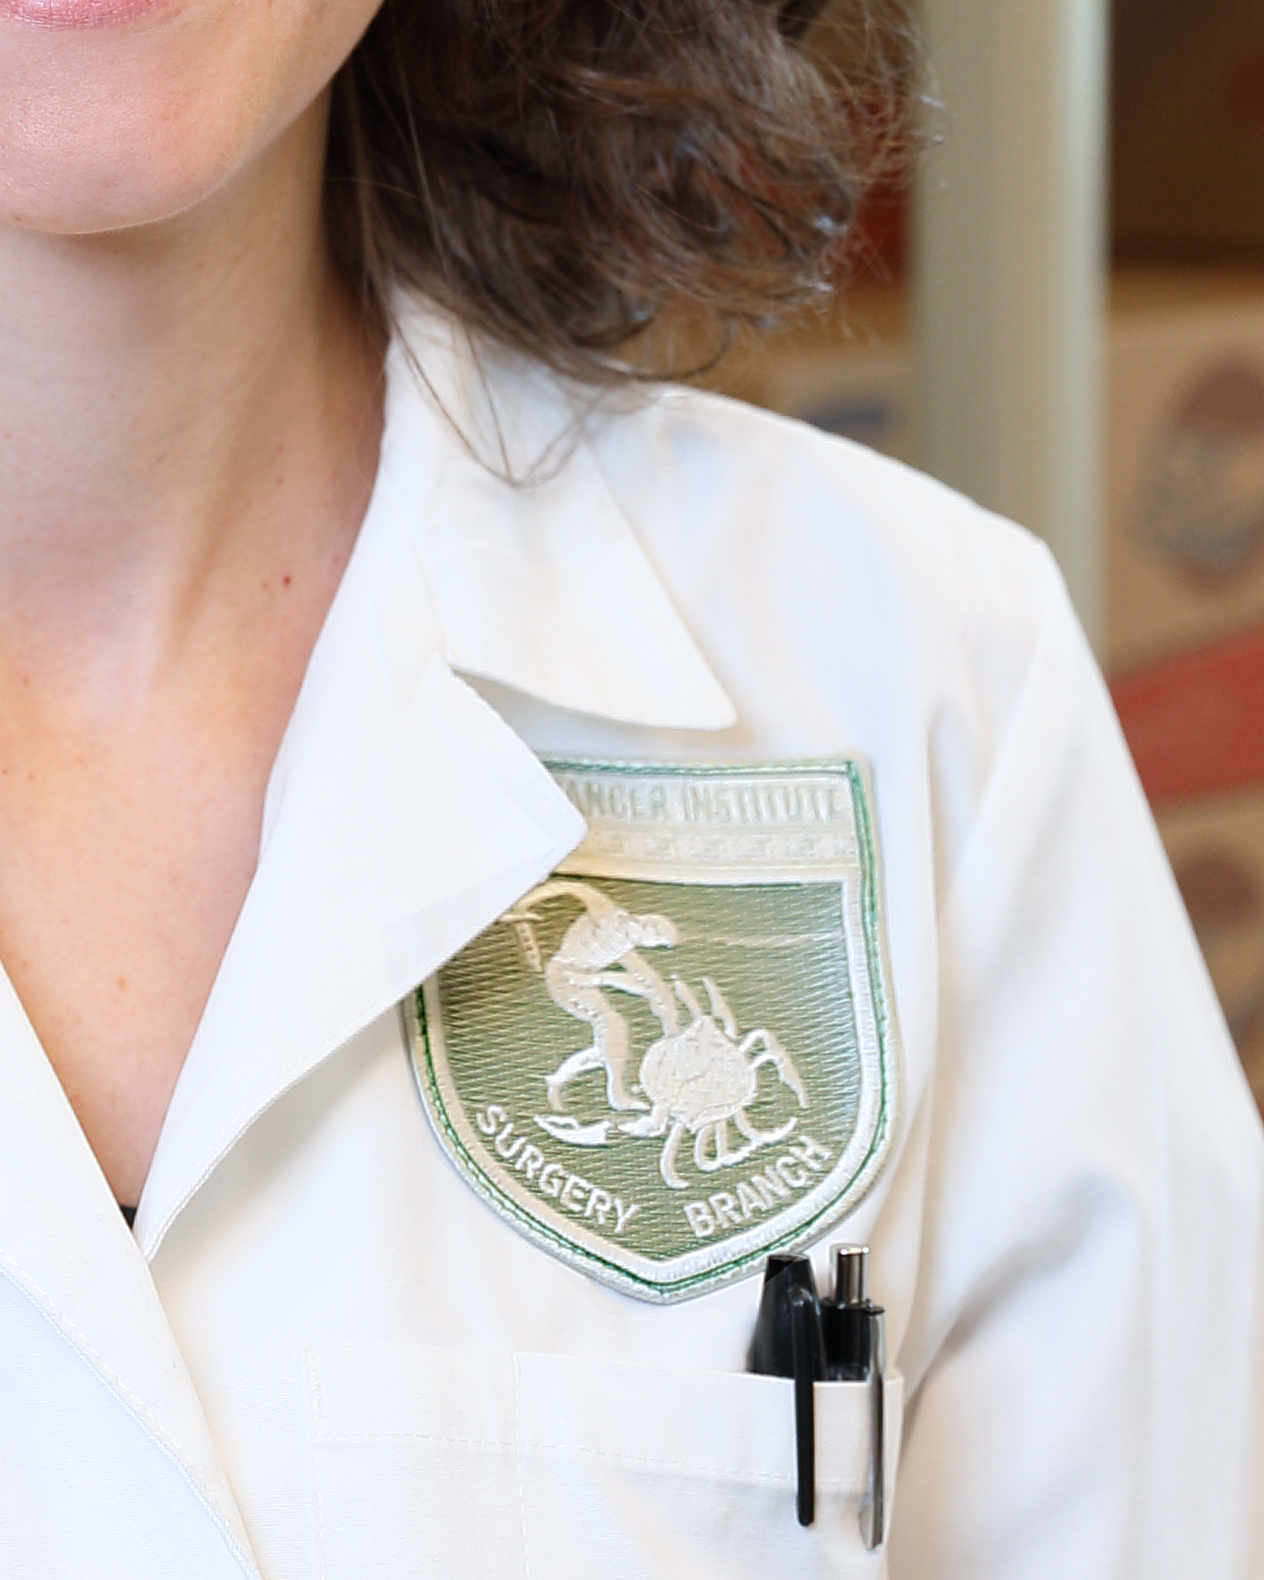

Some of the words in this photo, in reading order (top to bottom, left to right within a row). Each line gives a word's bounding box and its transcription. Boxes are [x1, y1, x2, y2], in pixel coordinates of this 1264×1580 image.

[556, 780, 668, 821] ANCER
[680, 782, 844, 823] INSTITUTE
[475, 1104, 638, 1234] SURGERY
[683, 1134, 833, 1238] BRANCH
